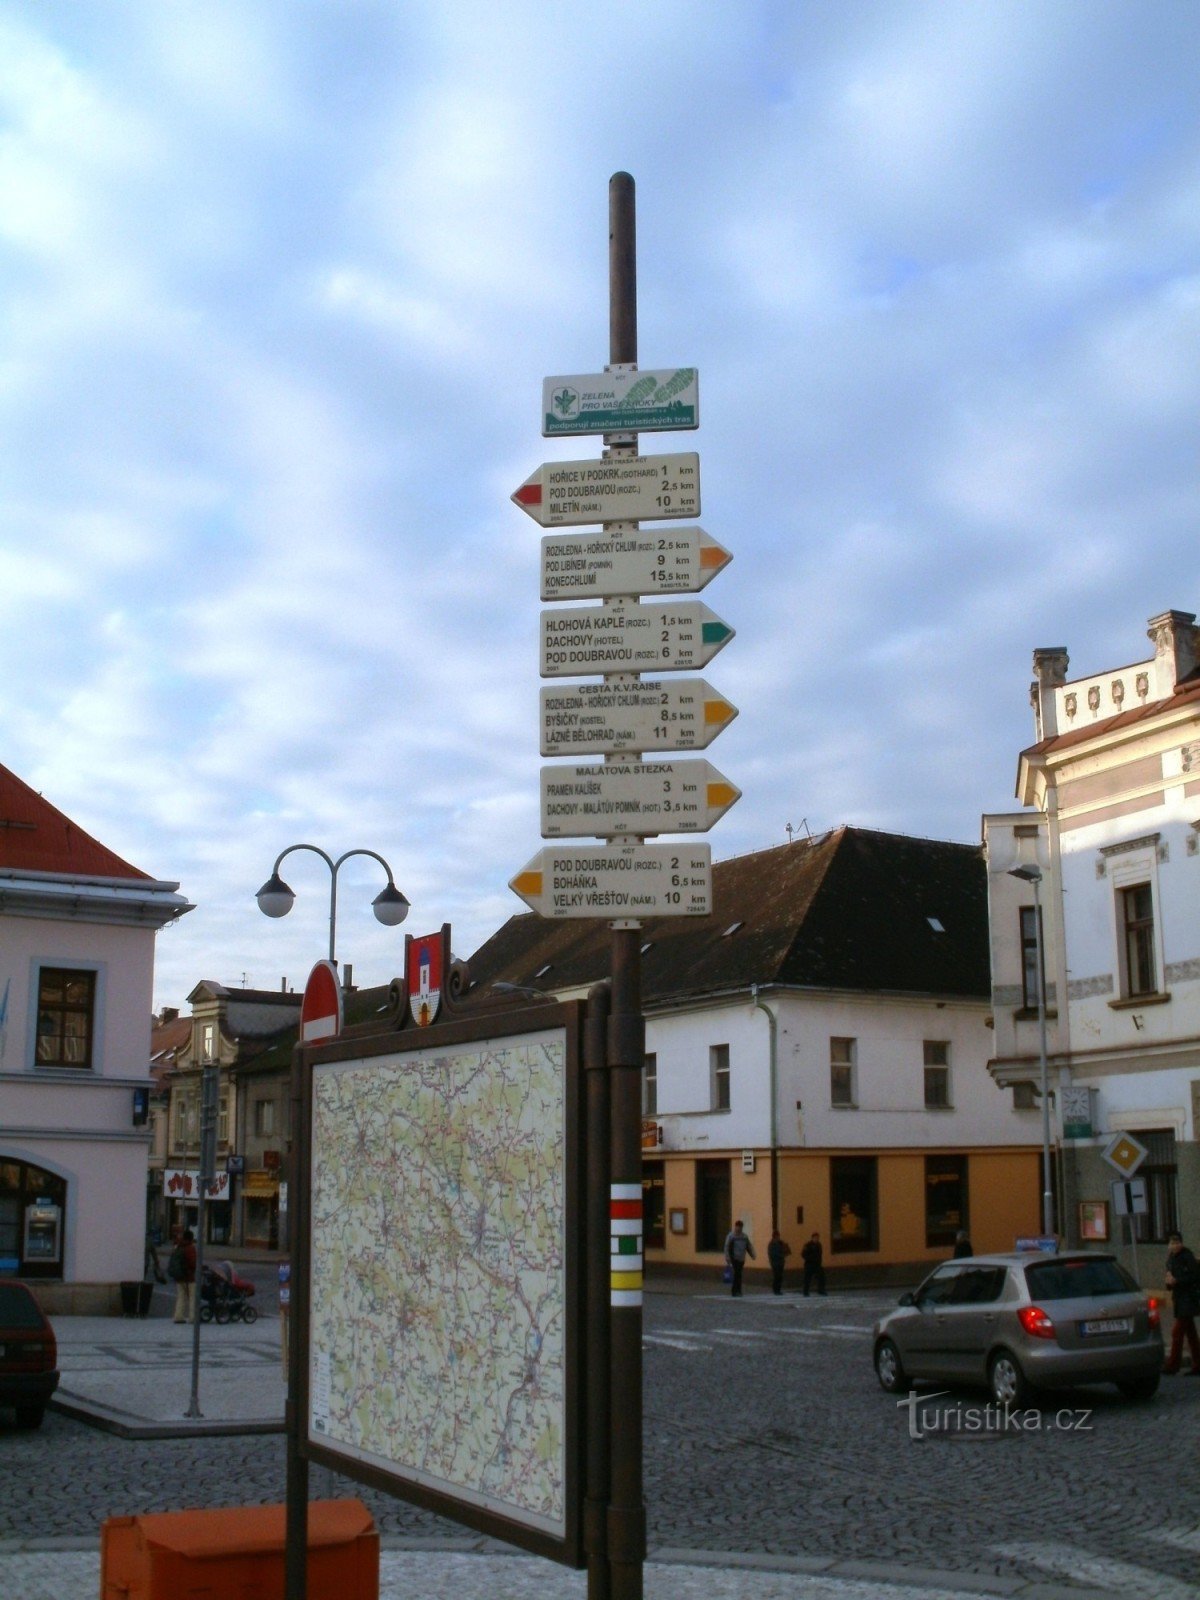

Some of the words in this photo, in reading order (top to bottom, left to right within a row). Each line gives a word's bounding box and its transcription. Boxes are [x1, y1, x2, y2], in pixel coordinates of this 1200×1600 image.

[582, 391, 615, 401] ZELENÁ
[602, 400, 623, 410] VAŠE
[550, 421, 589, 430] podporují
[590, 418, 622, 427] značení
[624, 416, 672, 426] turistických
[675, 416, 692, 424] tras
[550, 469, 579, 483] HOŘICE
[580, 471, 586, 481] V
[661, 465, 667, 475] 1
[680, 467, 694, 475] km
[550, 488, 566, 498] POD
[568, 484, 616, 498] DOUBRAVOU
[662, 481, 678, 491] 2,5
[550, 500, 580, 514] MILETÍN
[656, 496, 671, 507] 10
[546, 544, 582, 556] ROZHLEDNA
[587, 540, 614, 554] HOŘICKÝ
[615, 541, 637, 552] CHLUM
[658, 540, 673, 550] 2,5
[546, 561, 559, 571] POD
[561, 557, 587, 571] LIBÍNEM
[657, 555, 665, 565] 9
[545, 571, 597, 587] KONECCHLUMÍ
[650, 570, 673, 581] 15,5
[546, 616, 591, 631] HLOHOVÁ
[594, 617, 625, 629] KAPLE
[661, 615, 676, 626] 1,5
[546, 634, 593, 648] DACHOVY
[594, 636, 624, 647] (HOTEL)
[661, 630, 669, 641] 2
[546, 652, 566, 663] POD
[570, 649, 632, 662] DOUBRAVOU
[634, 650, 659, 660] (ROZC.)
[662, 647, 670, 658] 6
[679, 649, 693, 657] km
[578, 684, 611, 694] CESTA
[545, 697, 583, 710] ROZHLEDNA
[588, 694, 616, 708] HOŘICKÝ
[617, 694, 640, 707] CHLUM
[661, 693, 669, 704] 2
[680, 696, 694, 704] km
[545, 711, 579, 727] BYŠIČKY
[580, 716, 606, 726] (KOSTEL)
[661, 709, 677, 721] 8,5
[680, 712, 694, 720] km
[653, 726, 667, 738] 11
[680, 729, 695, 737] km
[633, 765, 673, 774] STEZKA
[547, 783, 574, 796] PRAMEN
[663, 780, 671, 792] 3
[682, 783, 697, 791] km
[547, 803, 578, 816] DACHOVY
[615, 799, 641, 813] POMNÍK
[663, 800, 680, 813] 3,5
[683, 803, 698, 811] km
[553, 859, 573, 872] POD
[575, 858, 632, 871] DOUBRAVOU
[634, 861, 662, 871] (ROZC.)
[671, 857, 679, 869] 2
[690, 860, 705, 868] km
[553, 874, 597, 889] BOHÁŇKA
[671, 874, 689, 887] 6,5
[691, 877, 705, 886] km
[553, 892, 583, 906] VELKÝ
[586, 890, 629, 906] VŘEŠŤOV
[664, 891, 681, 904] 10
[691, 895, 706, 903] km
